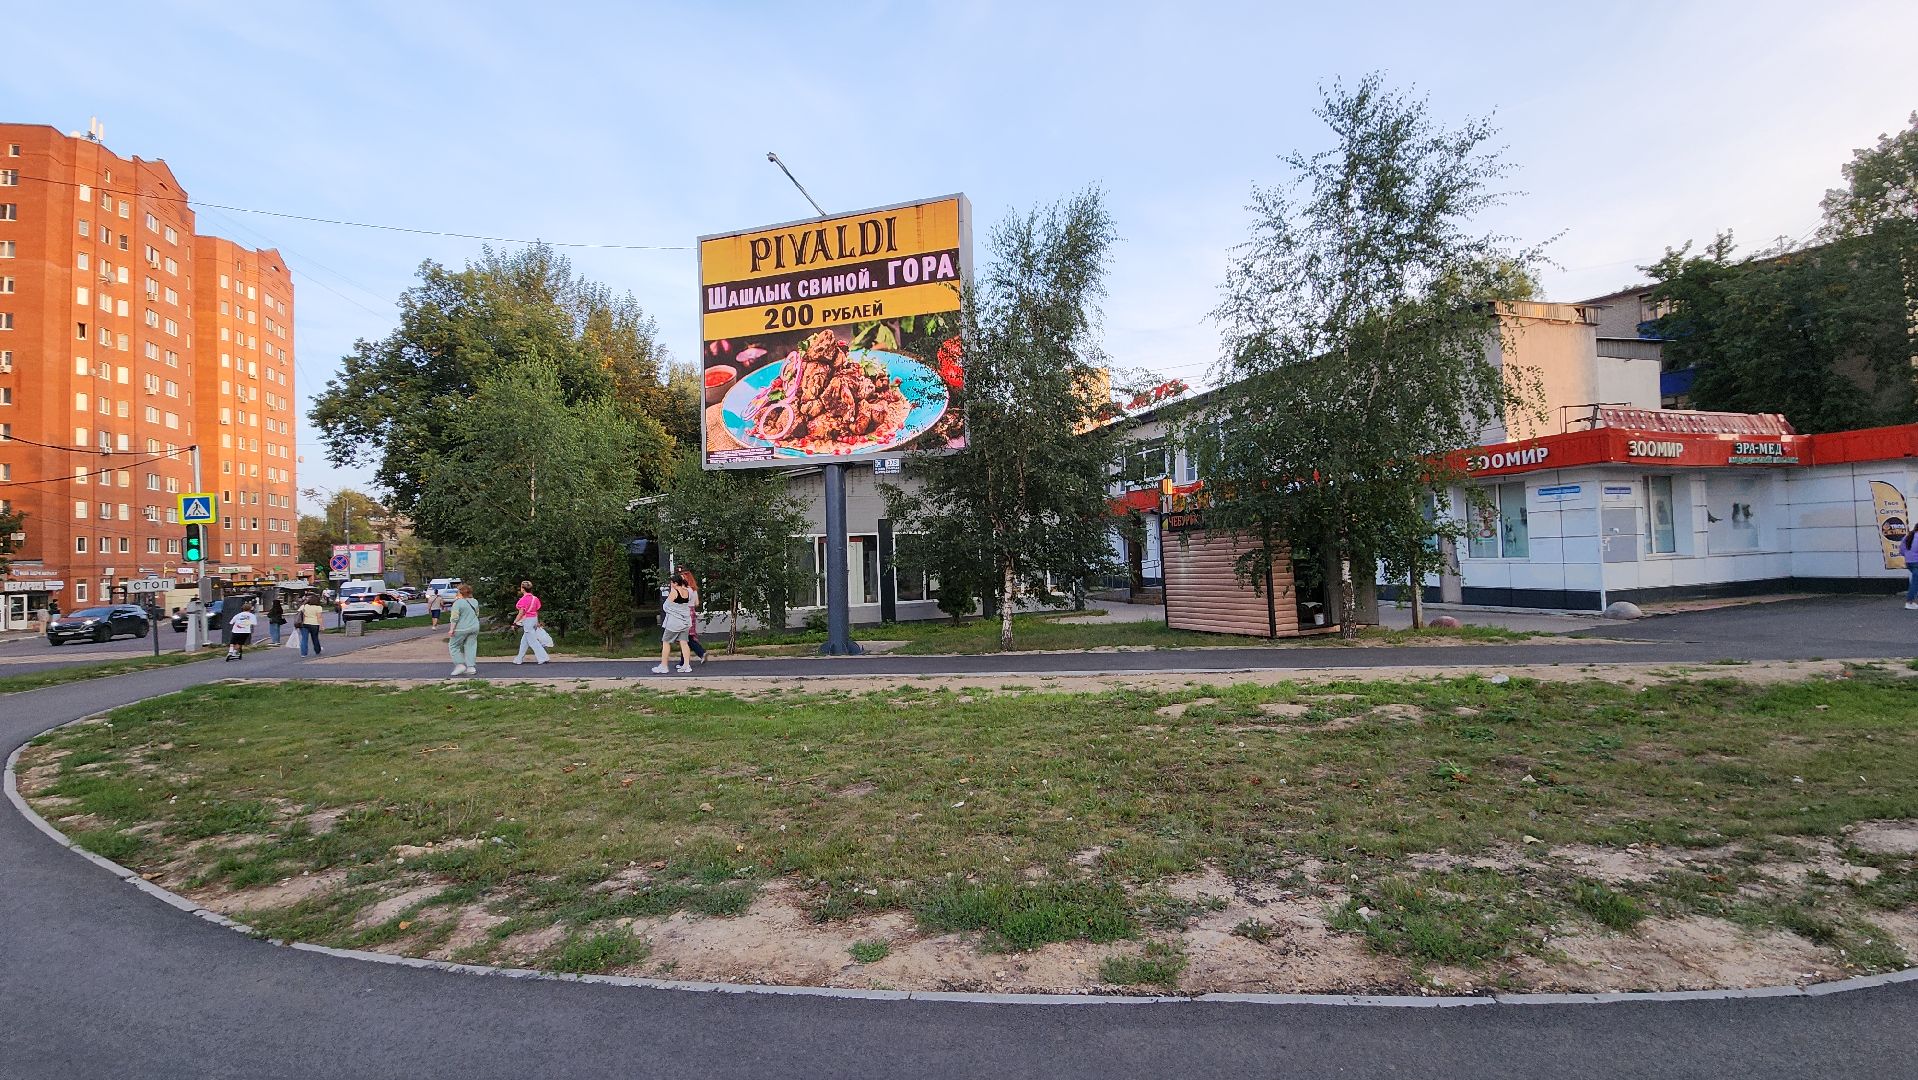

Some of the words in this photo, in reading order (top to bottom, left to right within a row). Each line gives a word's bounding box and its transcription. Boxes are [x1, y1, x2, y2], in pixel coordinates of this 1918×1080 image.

[750, 217, 898, 273] PIVALDI
[708, 281, 791, 310] ШАШЛЫК
[798, 268, 878, 298] СВИНОЙ.
[888, 253, 955, 286] ГОРА
[764, 303, 814, 330] 200
[822, 300, 883, 323] РУБЛЕЙ
[1628, 441, 1684, 457] ЗООМИР
[1736, 443, 1782, 455] ЭРА-МЕД
[133, 580, 169, 590] СТОП
